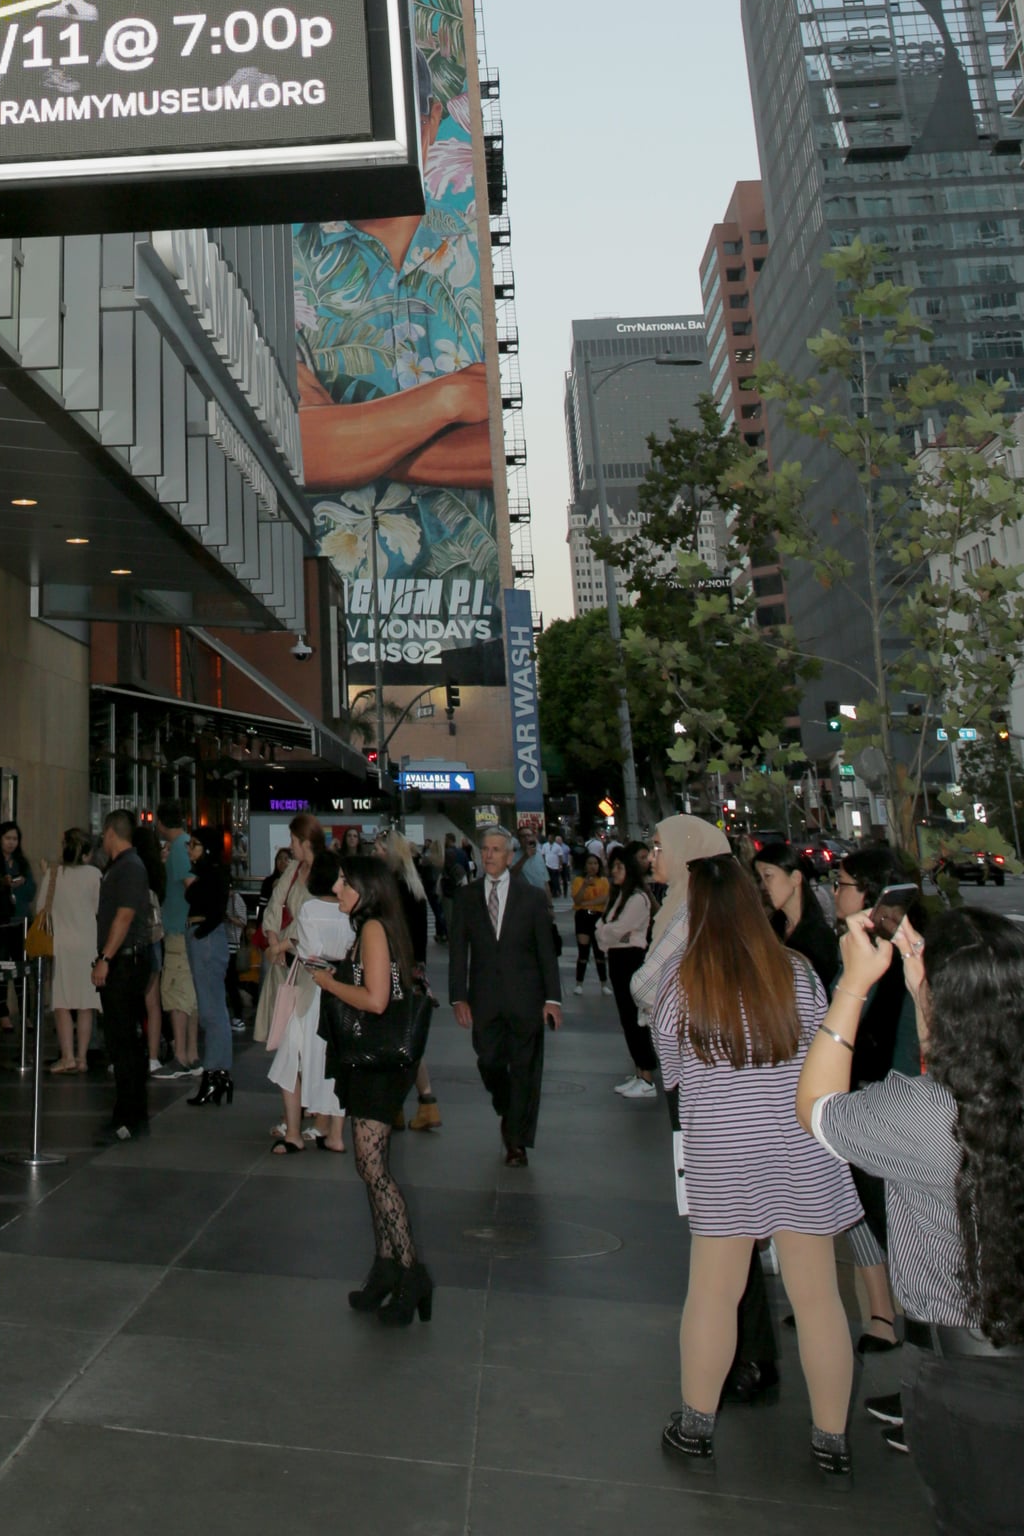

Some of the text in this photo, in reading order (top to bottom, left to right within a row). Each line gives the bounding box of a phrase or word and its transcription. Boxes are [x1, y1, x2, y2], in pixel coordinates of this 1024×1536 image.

[103, 17, 159, 71] @
[173, 7, 333, 58] 7:00p
[344, 579, 492, 615] GNUM P.I.
[367, 619, 492, 640] MONDAYS
[510, 626, 540, 790] CAR WASH
[405, 774, 450, 782] AVAILABLE
[332, 799, 372, 810] VI TIC
